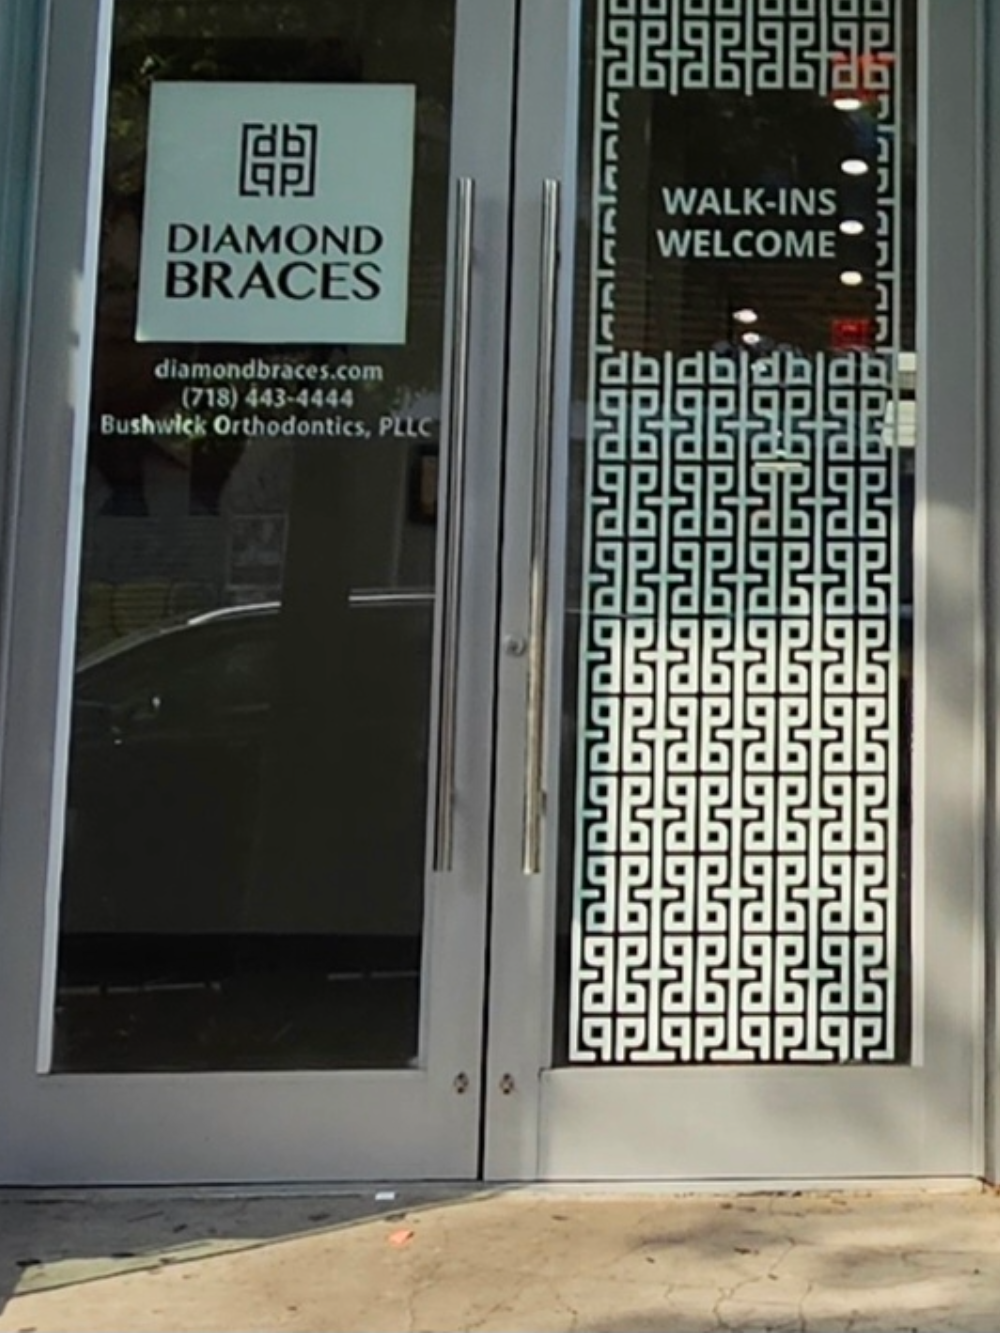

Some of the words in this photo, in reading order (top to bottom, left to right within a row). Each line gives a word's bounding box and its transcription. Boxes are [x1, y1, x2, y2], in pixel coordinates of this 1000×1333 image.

[661, 187, 838, 217] WALK-INS
[166, 223, 384, 256] DIAMOND
[656, 229, 838, 258] WELCOME
[164, 260, 383, 301] BRACES
[154, 357, 384, 382] diamondbraces.com
[181, 386, 239, 410] (718)
[245, 386, 355, 408] 443-4444
[100, 415, 207, 436] Bushwick
[213, 415, 372, 439] Orthodontics,
[378, 417, 433, 437] PLLC
